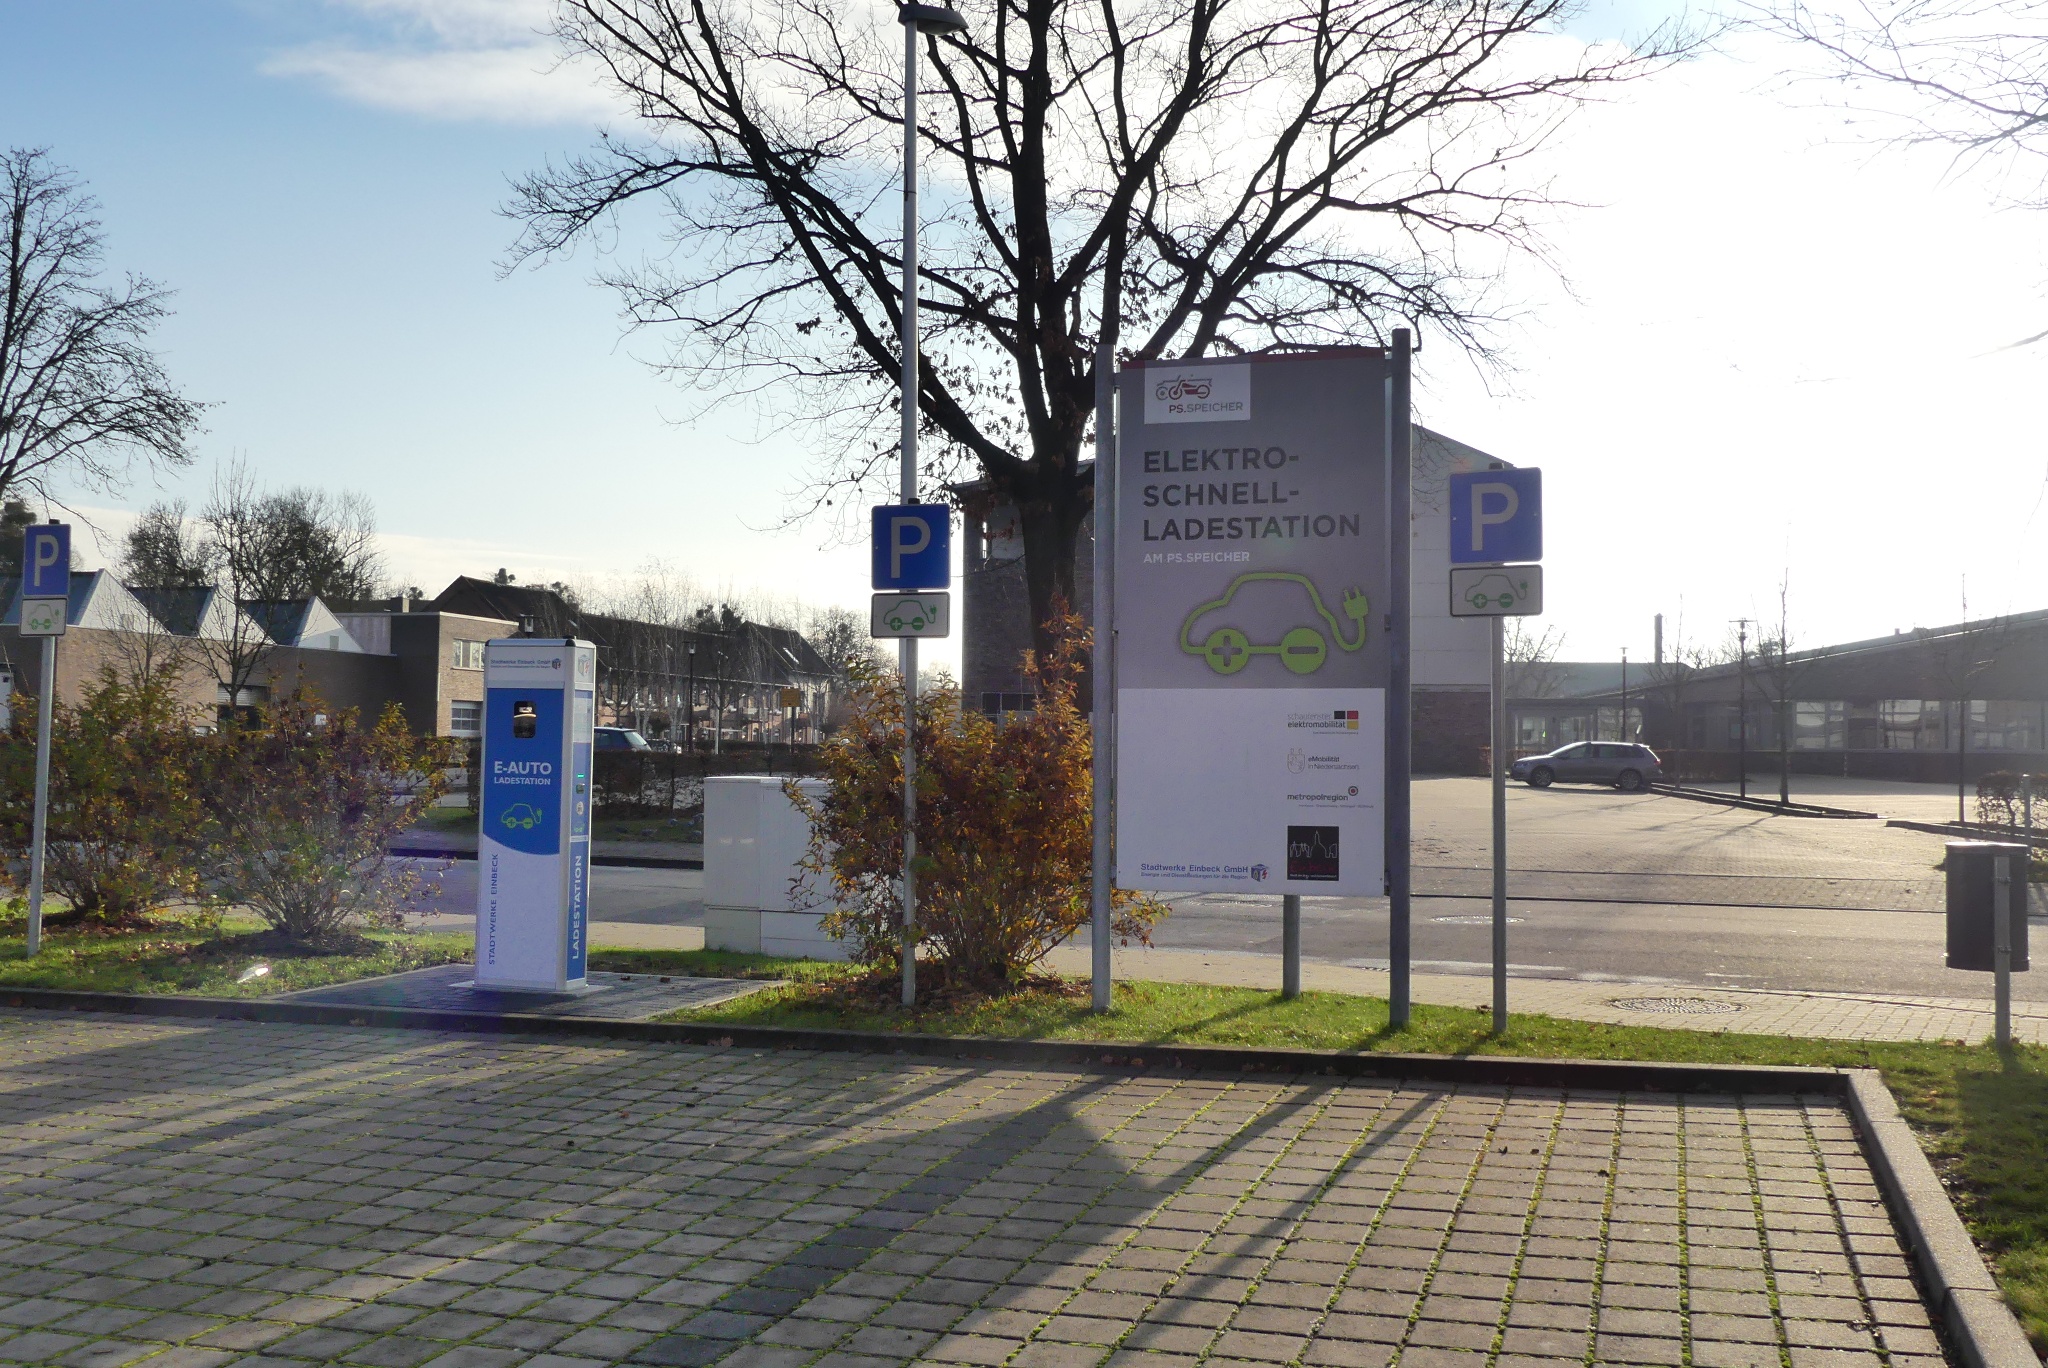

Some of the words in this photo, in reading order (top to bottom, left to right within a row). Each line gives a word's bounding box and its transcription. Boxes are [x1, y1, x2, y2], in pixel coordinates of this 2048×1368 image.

[1169, 402, 1243, 413] PS.SPEICHER
[1144, 446, 1299, 473] ELEKTRO-
[1143, 481, 1299, 507] SCHNELL-
[1143, 513, 1360, 541] LADESTATION
[1471, 482, 1519, 551] P
[890, 516, 931, 578] P
[1143, 553, 1163, 563] AM
[1167, 551, 1250, 563] PS.SPEICHER
[33, 534, 59, 587] P
[1287, 720, 1346, 728] elektromobilität
[494, 761, 552, 775] E-AUTO
[494, 776, 551, 785] LADESTATION
[1287, 793, 1348, 802] metropolregion
[490, 853, 499, 895] EINBECK
[1140, 863, 1186, 871] Stadtwerke
[1189, 864, 1220, 872] Einbeck
[1223, 865, 1249, 873] GmbH
[572, 855, 582, 959] LADESTATION
[488, 899, 497, 965] STADTWERKE
